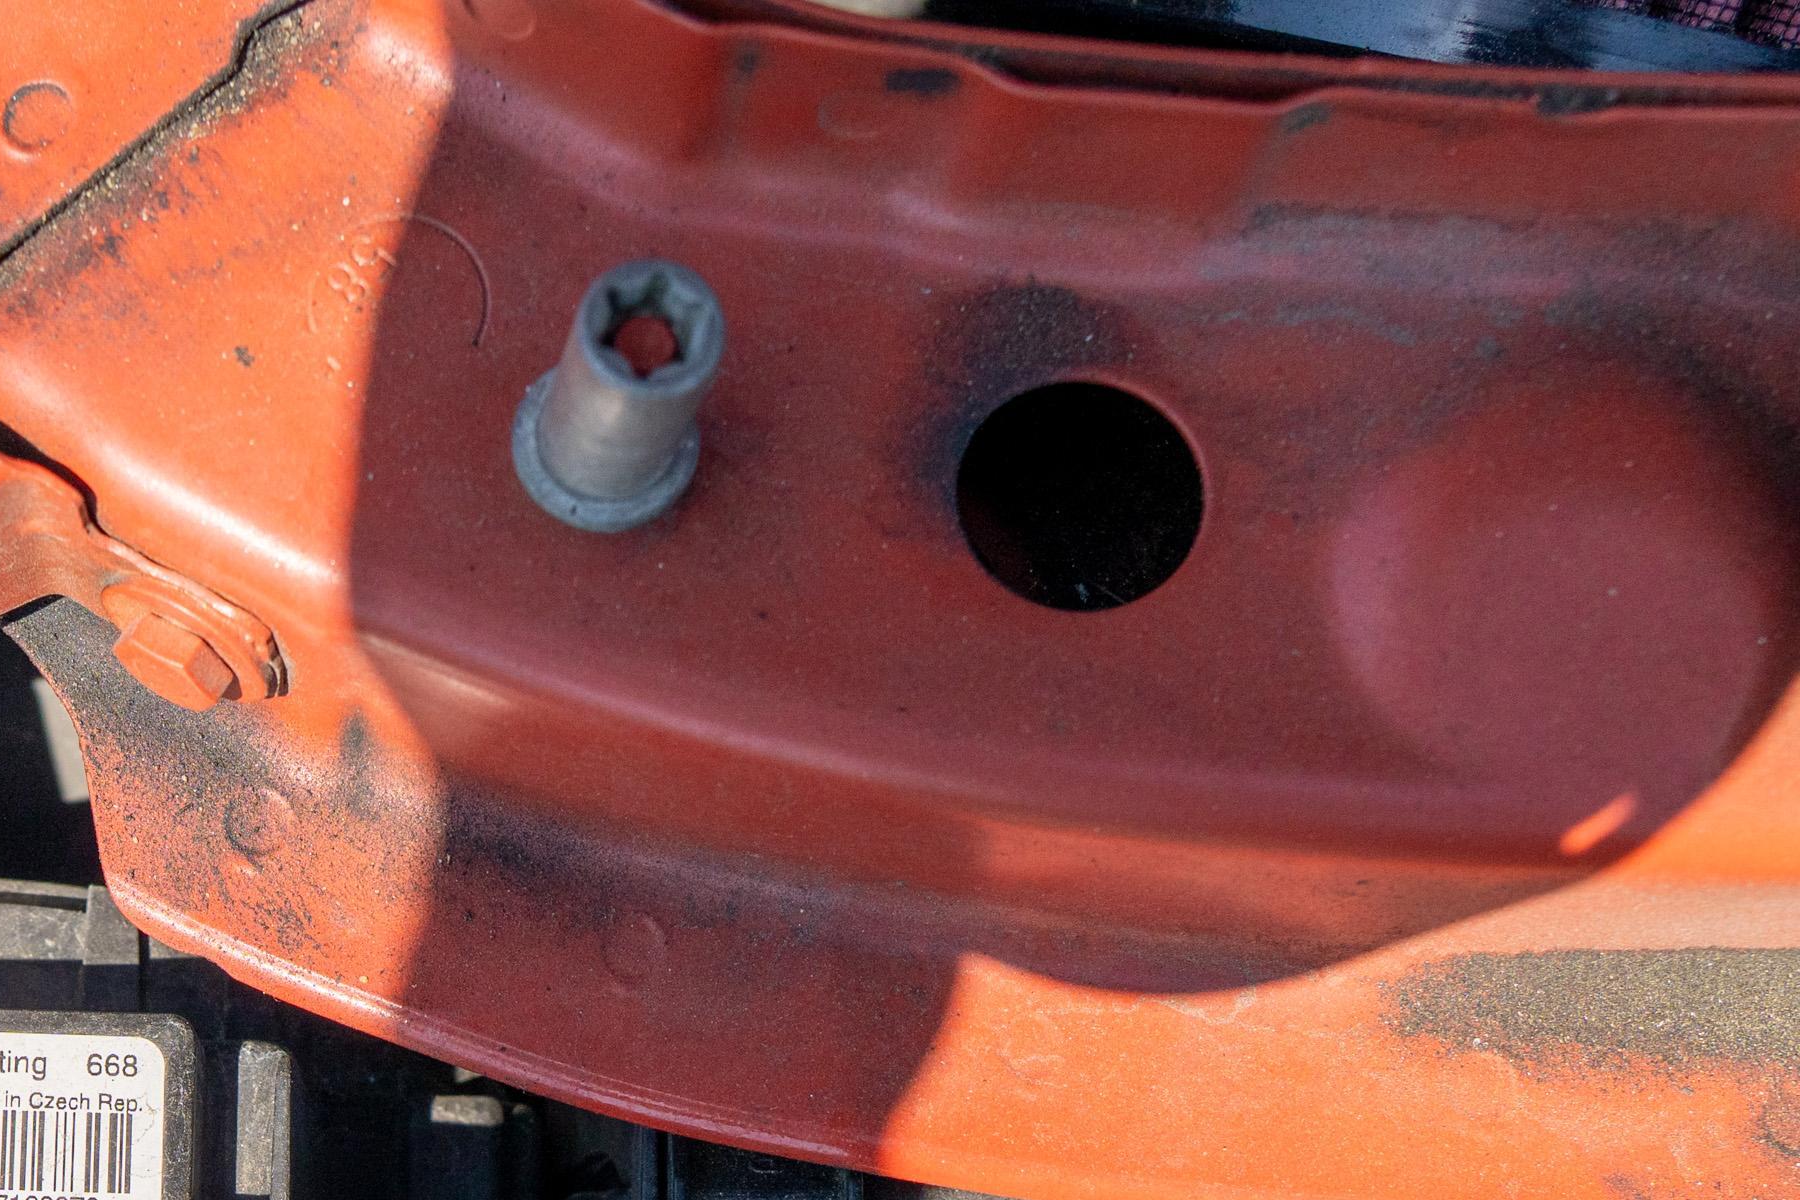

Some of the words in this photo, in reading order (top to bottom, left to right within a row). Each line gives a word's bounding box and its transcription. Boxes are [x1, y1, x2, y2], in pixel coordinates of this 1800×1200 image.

[86, 1053, 138, 1077] 668
[5, 1090, 21, 1108] in
[29, 1091, 90, 1111] Czech
[98, 1092, 143, 1113] Rep.
